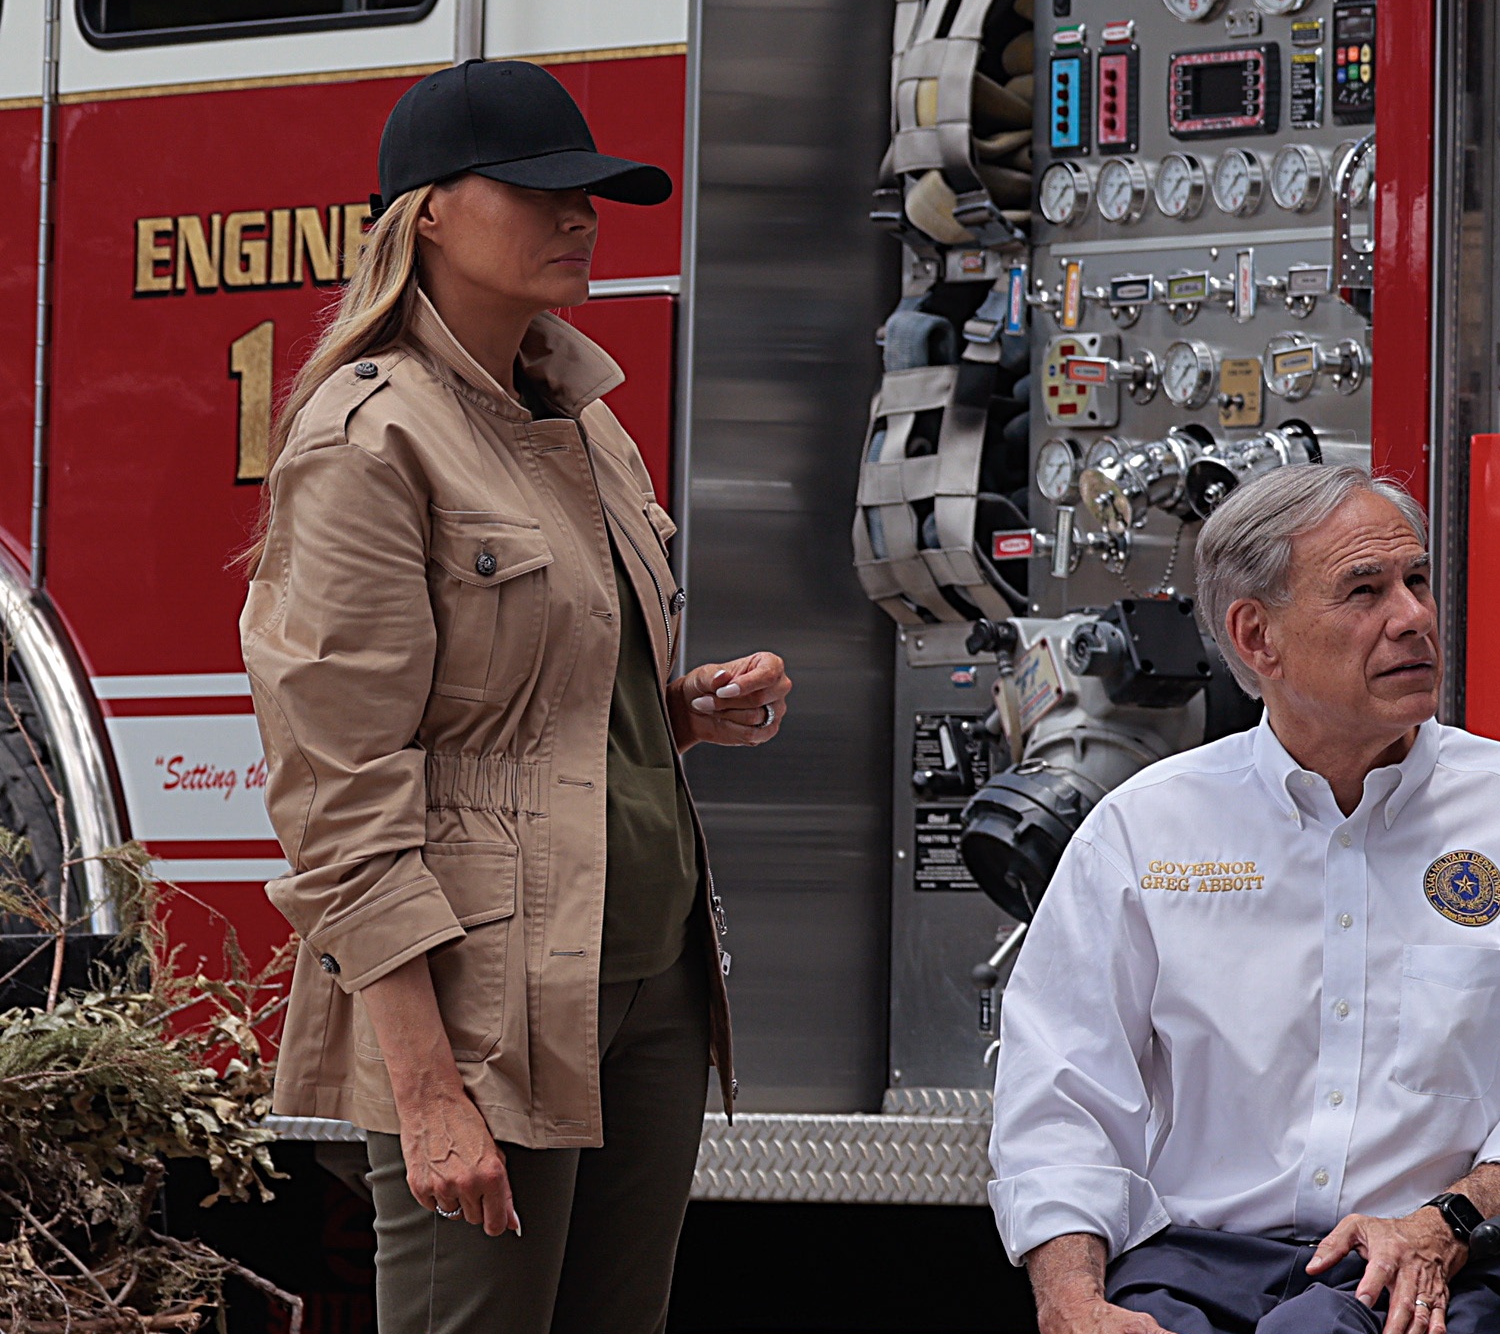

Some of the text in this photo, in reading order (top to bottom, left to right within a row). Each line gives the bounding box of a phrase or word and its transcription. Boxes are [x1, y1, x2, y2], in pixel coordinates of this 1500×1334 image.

[245, 757, 267, 789] th
[1149, 860, 1257, 876] GOVERNOR
[1431, 853, 1470, 873] MILITARY
[1140, 875, 1265, 892] GREG ABBOTT
[1426, 872, 1437, 897] TEXAS
